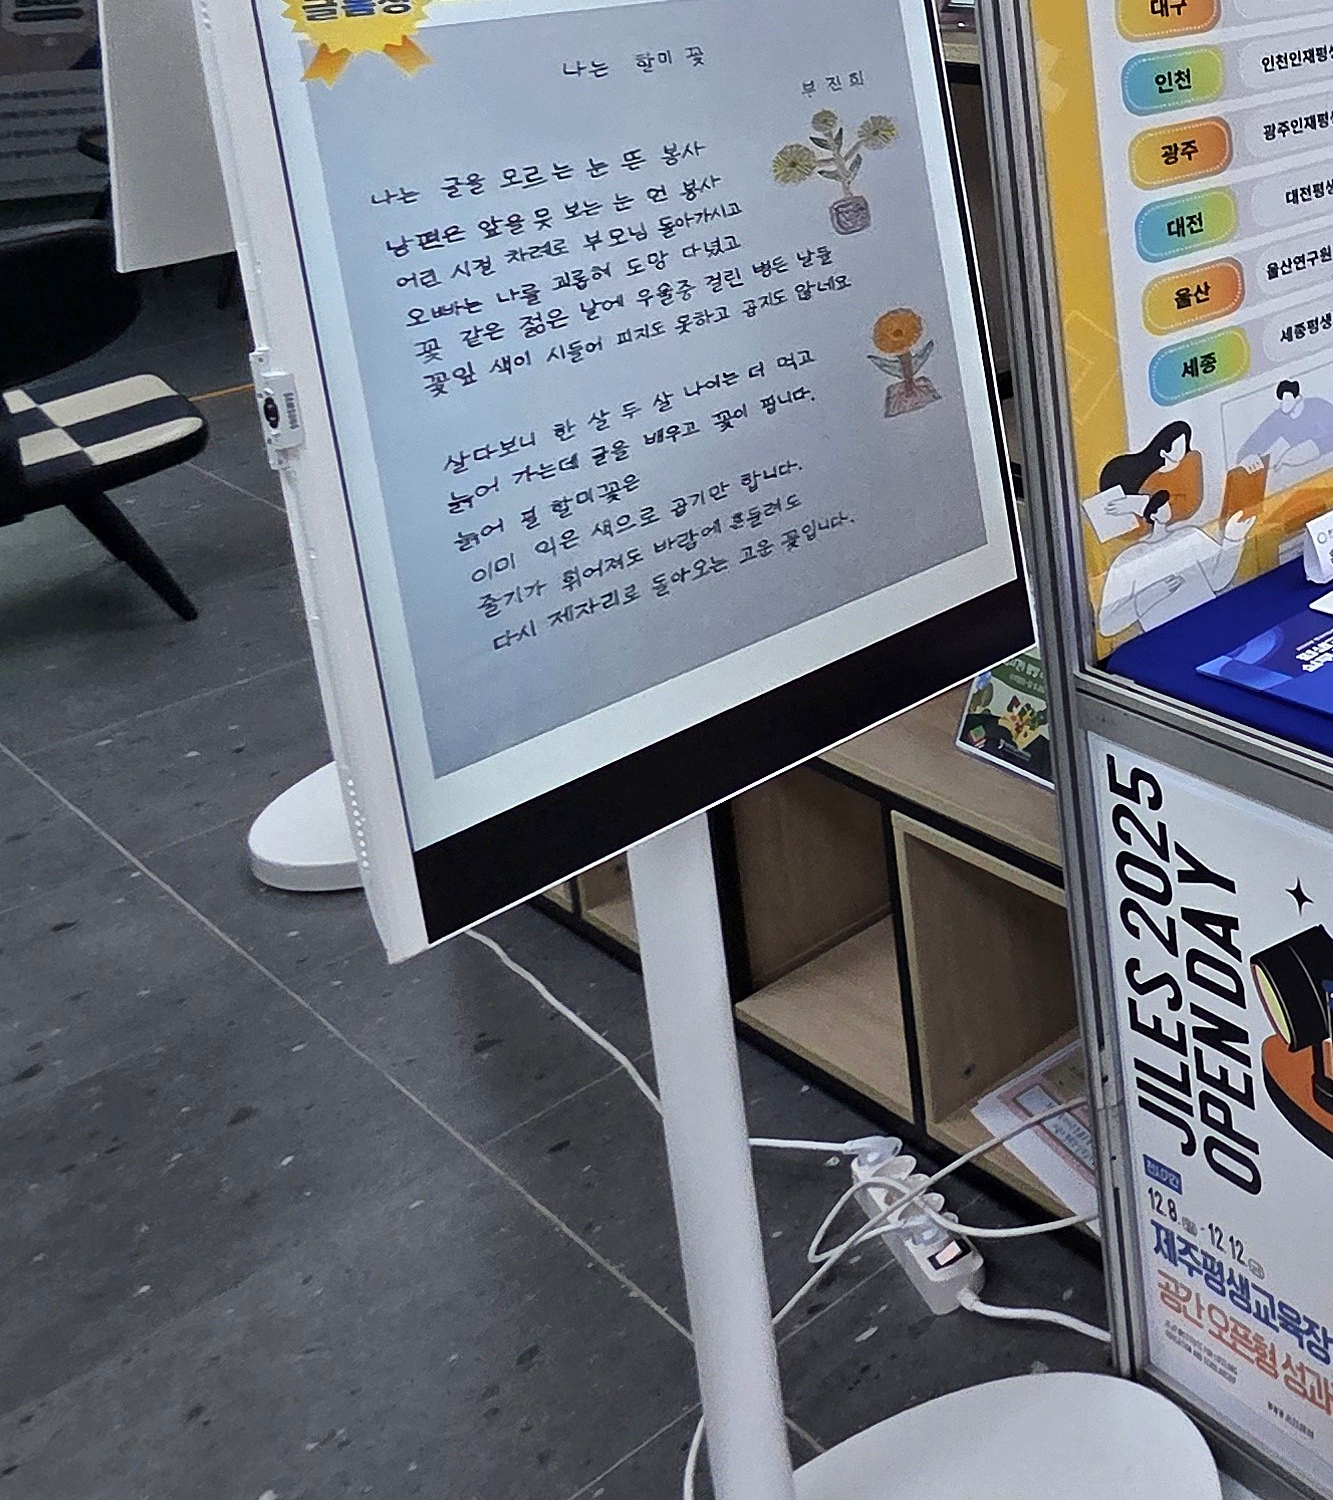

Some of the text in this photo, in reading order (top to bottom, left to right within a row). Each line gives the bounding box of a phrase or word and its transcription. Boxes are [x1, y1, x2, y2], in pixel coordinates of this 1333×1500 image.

[1154, 68, 1191, 94] 인천
[1161, 139, 1198, 165] 광주
[396, 202, 742, 288] 어린 시절 차례로 부모님 돌아가시고
[1166, 212, 1204, 237] 대전
[1266, 245, 1332, 280] 울산연구원
[1174, 281, 1210, 309] 울산
[1181, 351, 1217, 378] 세종
[443, 349, 816, 474] 살다보니 한 살 두 살 나이는 더 먹고
[1106, 753, 1178, 958] 2025
[1173, 841, 1261, 1195] OPEN DAY
[1124, 957, 1196, 1156] JILES
[1157, 1269, 1205, 1330] 공간
[1208, 1302, 1279, 1380] 오픈형
